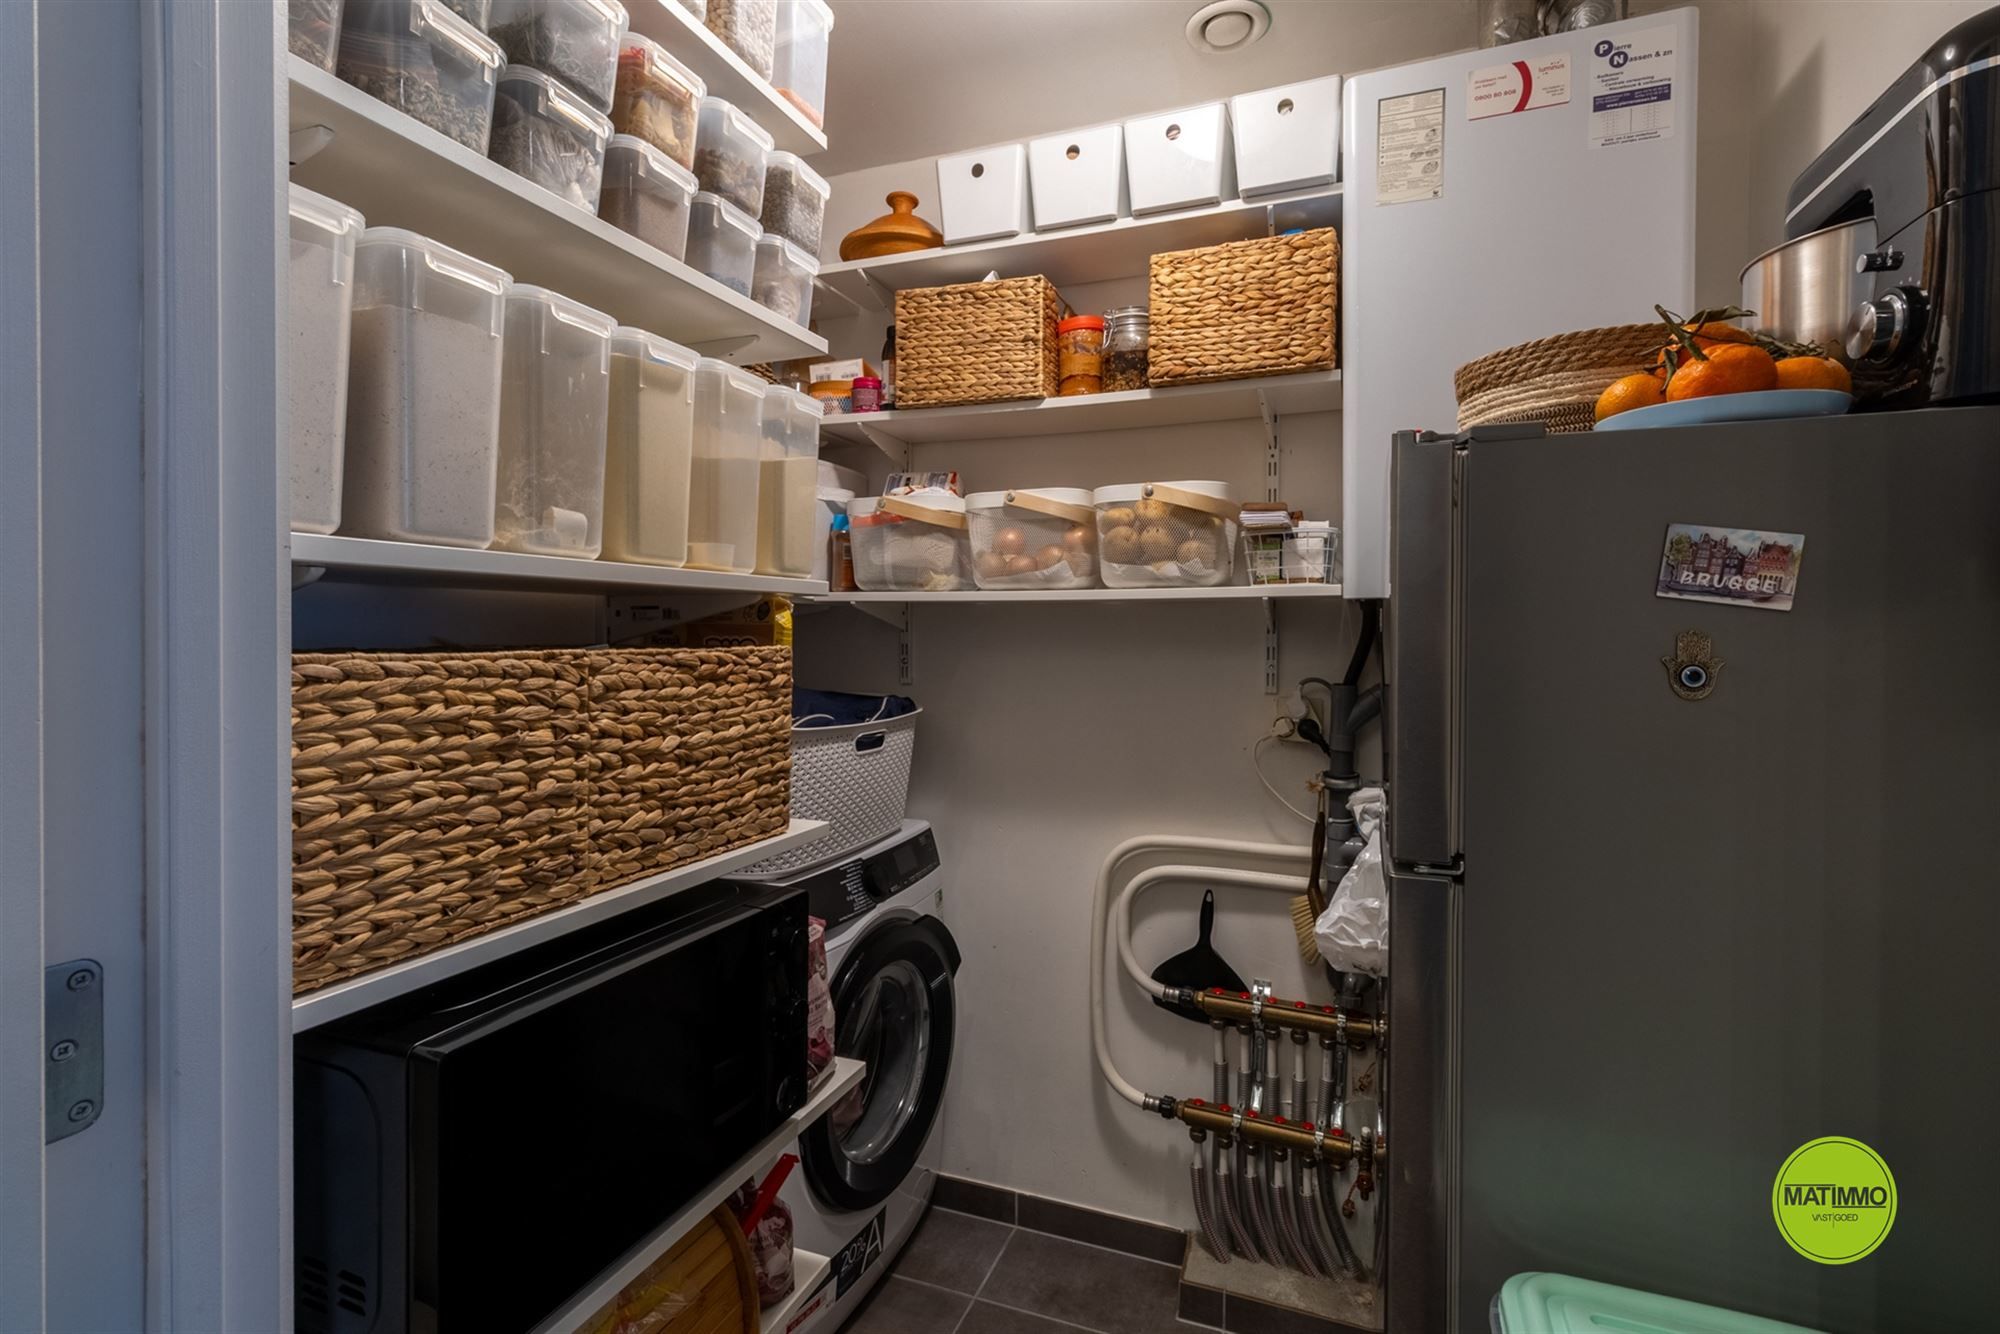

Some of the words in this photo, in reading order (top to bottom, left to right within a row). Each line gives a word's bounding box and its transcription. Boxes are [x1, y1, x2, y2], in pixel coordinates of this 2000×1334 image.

[1598, 42, 1632, 55] Pierre
[1612, 52, 1653, 66] Nassen
[1679, 570, 1776, 594] BRUGGE
[861, 1217, 882, 1275] A
